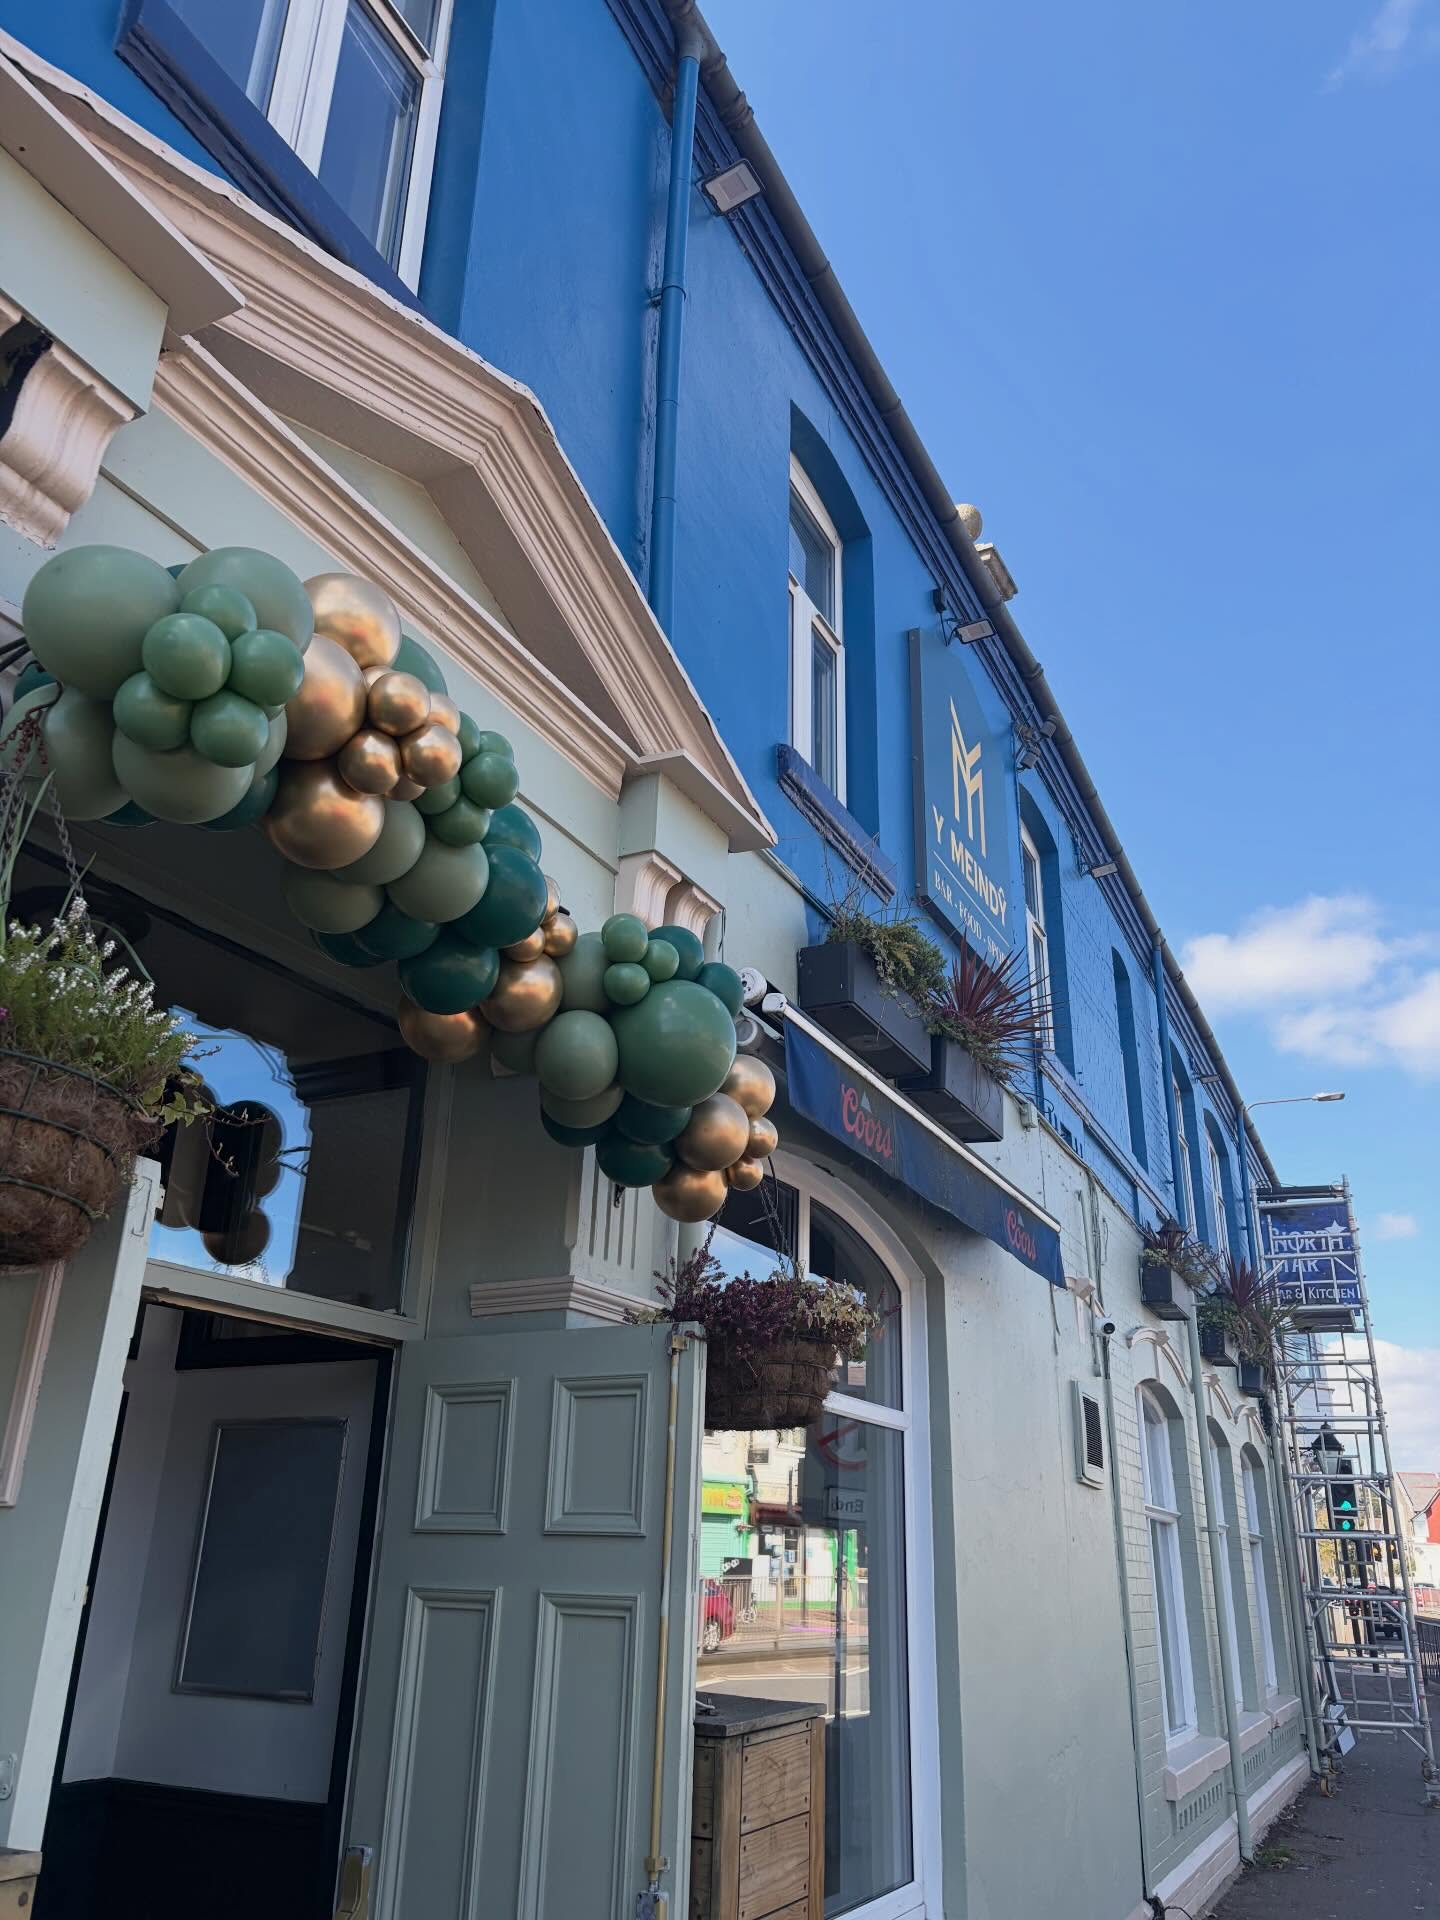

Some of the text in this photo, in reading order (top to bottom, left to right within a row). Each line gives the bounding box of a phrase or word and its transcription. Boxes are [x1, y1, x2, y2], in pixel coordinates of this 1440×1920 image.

[932, 804, 944, 845] Y
[934, 869, 954, 908] BAR
[959, 900, 982, 941] FOOD
[841, 1083, 892, 1158] Coors
[1005, 1208, 1037, 1261] Coors
[1273, 1227, 1345, 1252] NORTH
[1295, 1288, 1303, 1299] &
